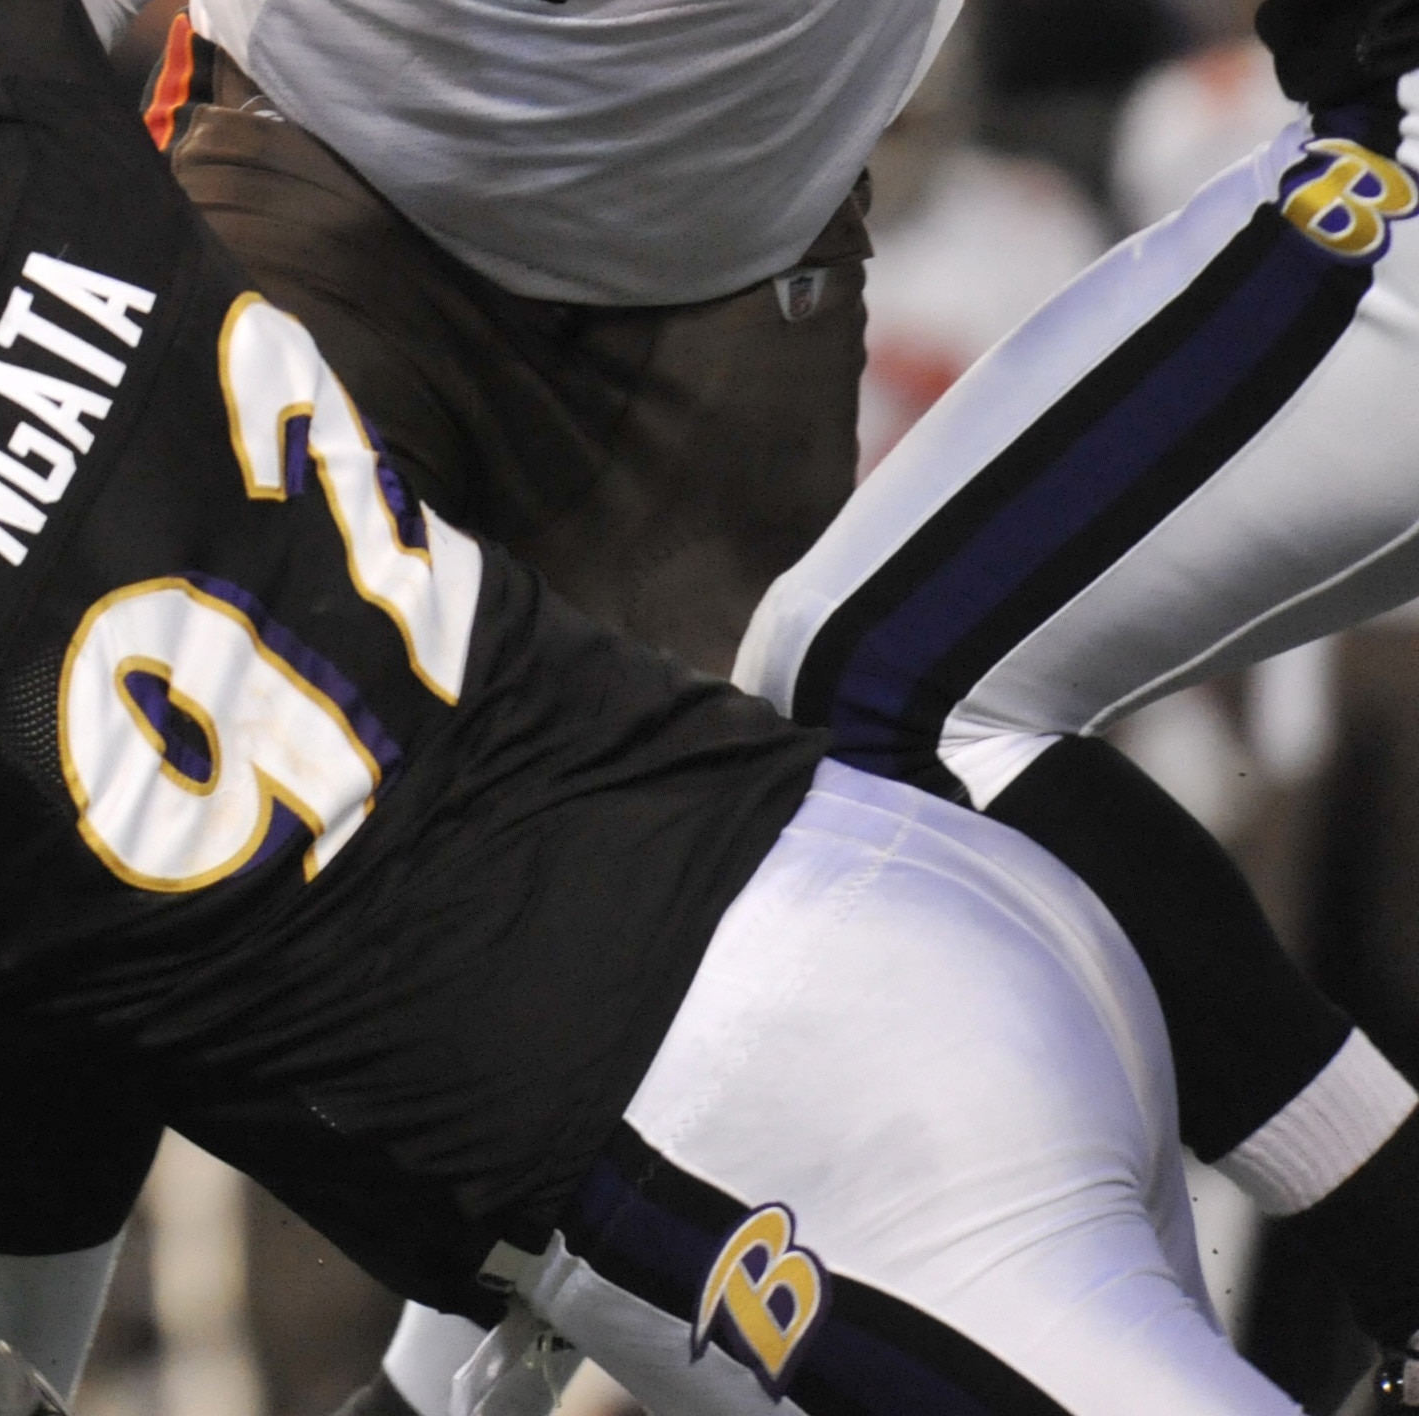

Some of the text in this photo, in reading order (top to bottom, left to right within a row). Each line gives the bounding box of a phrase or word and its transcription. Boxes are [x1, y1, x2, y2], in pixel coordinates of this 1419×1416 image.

[1281, 138, 1419, 258] B
[57, 290, 484, 895] 92
[696, 1205, 822, 1382] B
